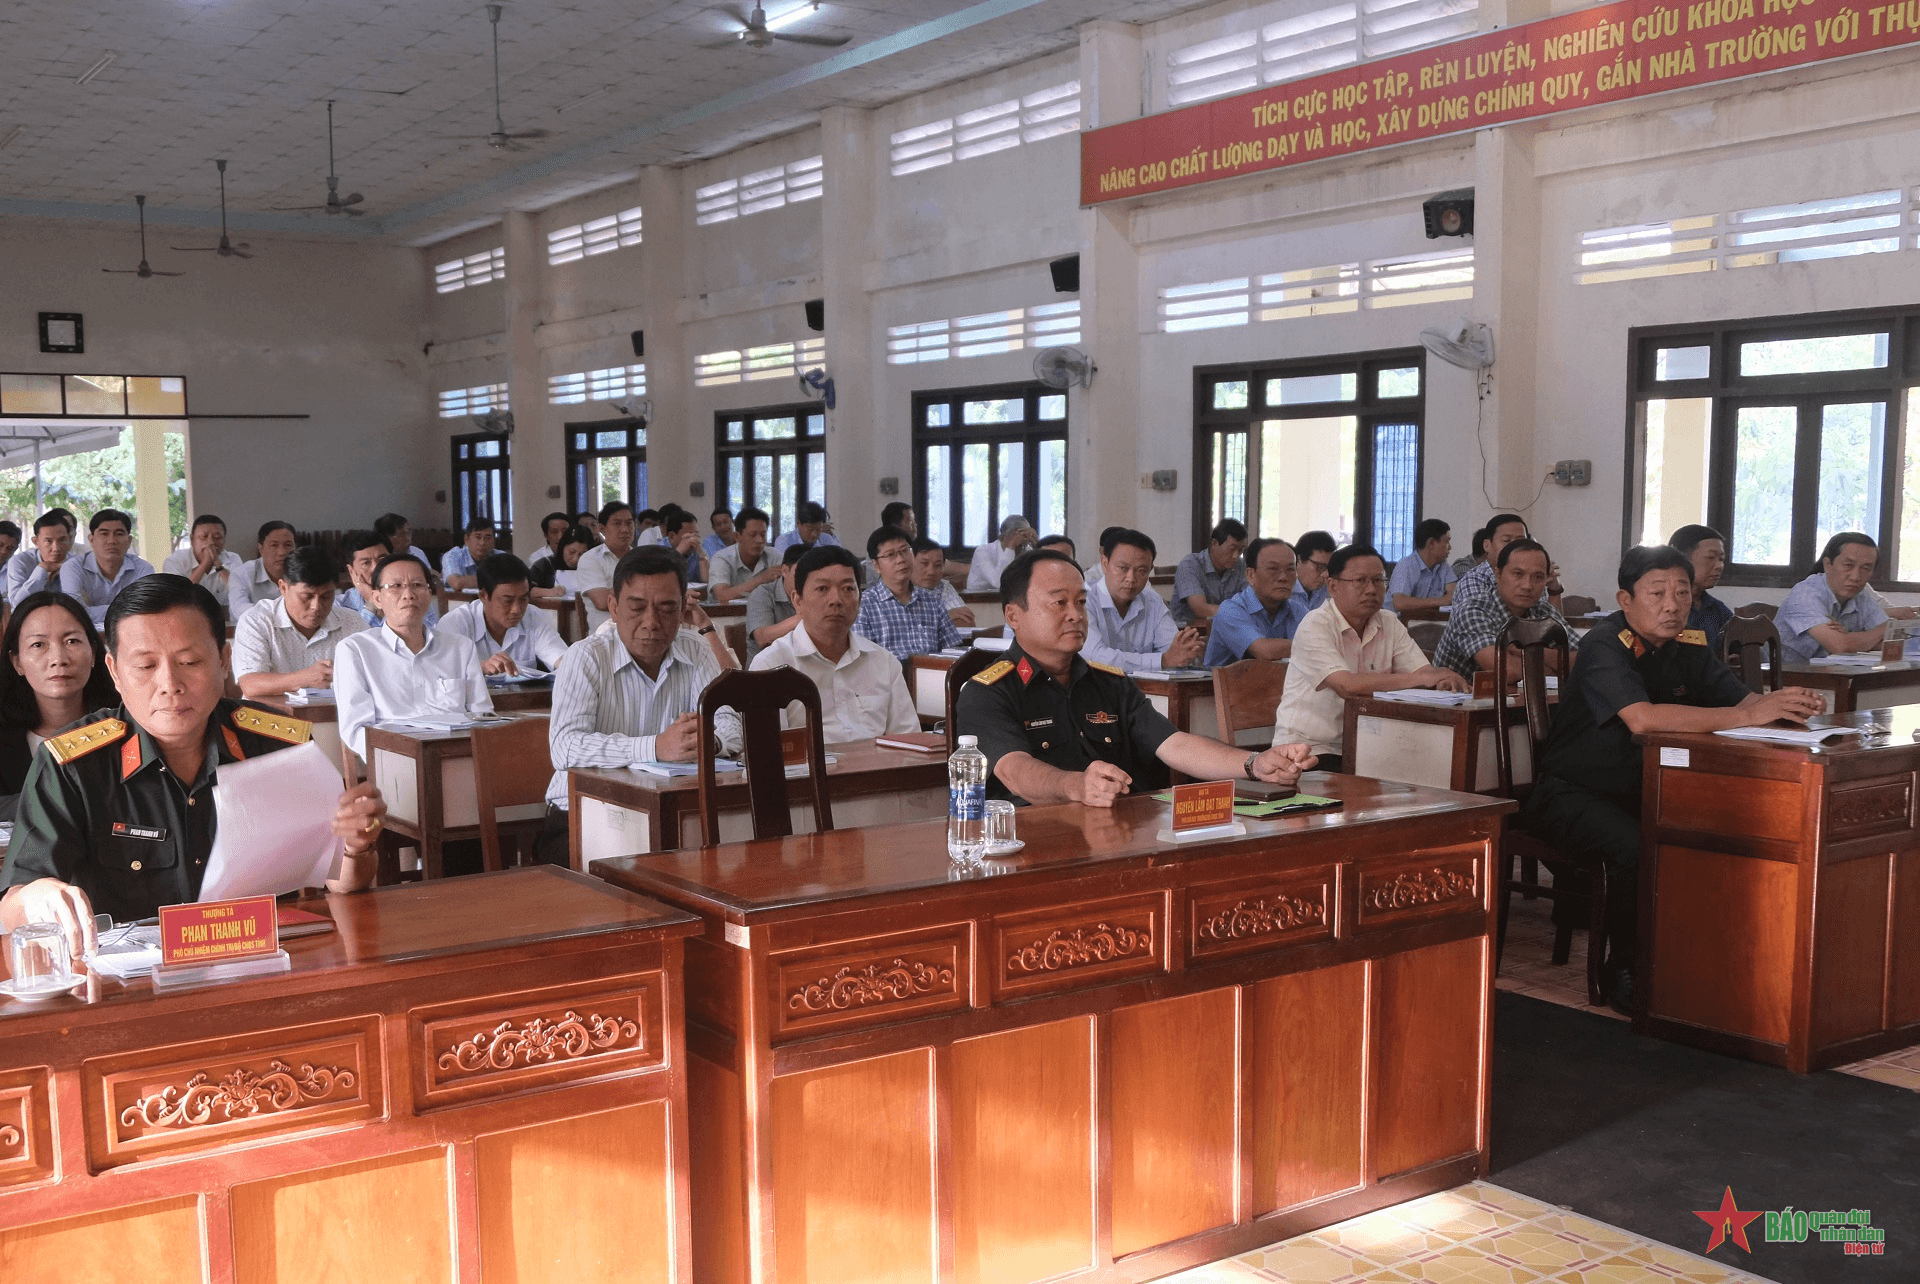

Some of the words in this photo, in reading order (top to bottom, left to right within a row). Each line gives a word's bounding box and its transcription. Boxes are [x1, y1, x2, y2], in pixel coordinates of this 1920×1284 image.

[1100, 166, 1136, 193] NÂNG
[1139, 161, 1167, 185] CAO
[1170, 145, 1208, 179] CHẤT
[1212, 140, 1263, 170] LƯỢNG
[1267, 132, 1300, 161] DẠY
[1304, 122, 1325, 151] VÀ
[1331, 117, 1371, 147] HỌC,
[1376, 105, 1412, 137] XÂY
[1418, 96, 1469, 129] DỰNG
[1474, 80, 1535, 116] CHÍNH
[1541, 71, 1589, 105] QUY,
[1596, 51, 1641, 91] GẮN
[1649, 41, 1696, 81] NHÀ
[1704, 23, 1807, 69] TRƯỜNG
[1814, 6, 1860, 47] VỚI
[1252, 100, 1289, 128] TÍCH
[1293, 89, 1327, 121] CỰC
[1332, 82, 1368, 112] HỌC
[1372, 69, 1414, 102] TẬP,
[1419, 58, 1459, 91] RÈN
[1465, 40, 1537, 81] LUYỆN,
[1543, 18, 1625, 63] NGHIÊN
[1631, 6, 1680, 43] CỨU
[1687, 0, 1755, 31] KHOA
[181, 924, 208, 944] PHAN
[210, 921, 242, 941] THANH
[243, 916, 257, 937] VŨ
[201, 908, 226, 920] THƯỢNG
[226, 906, 235, 917] TÁ
